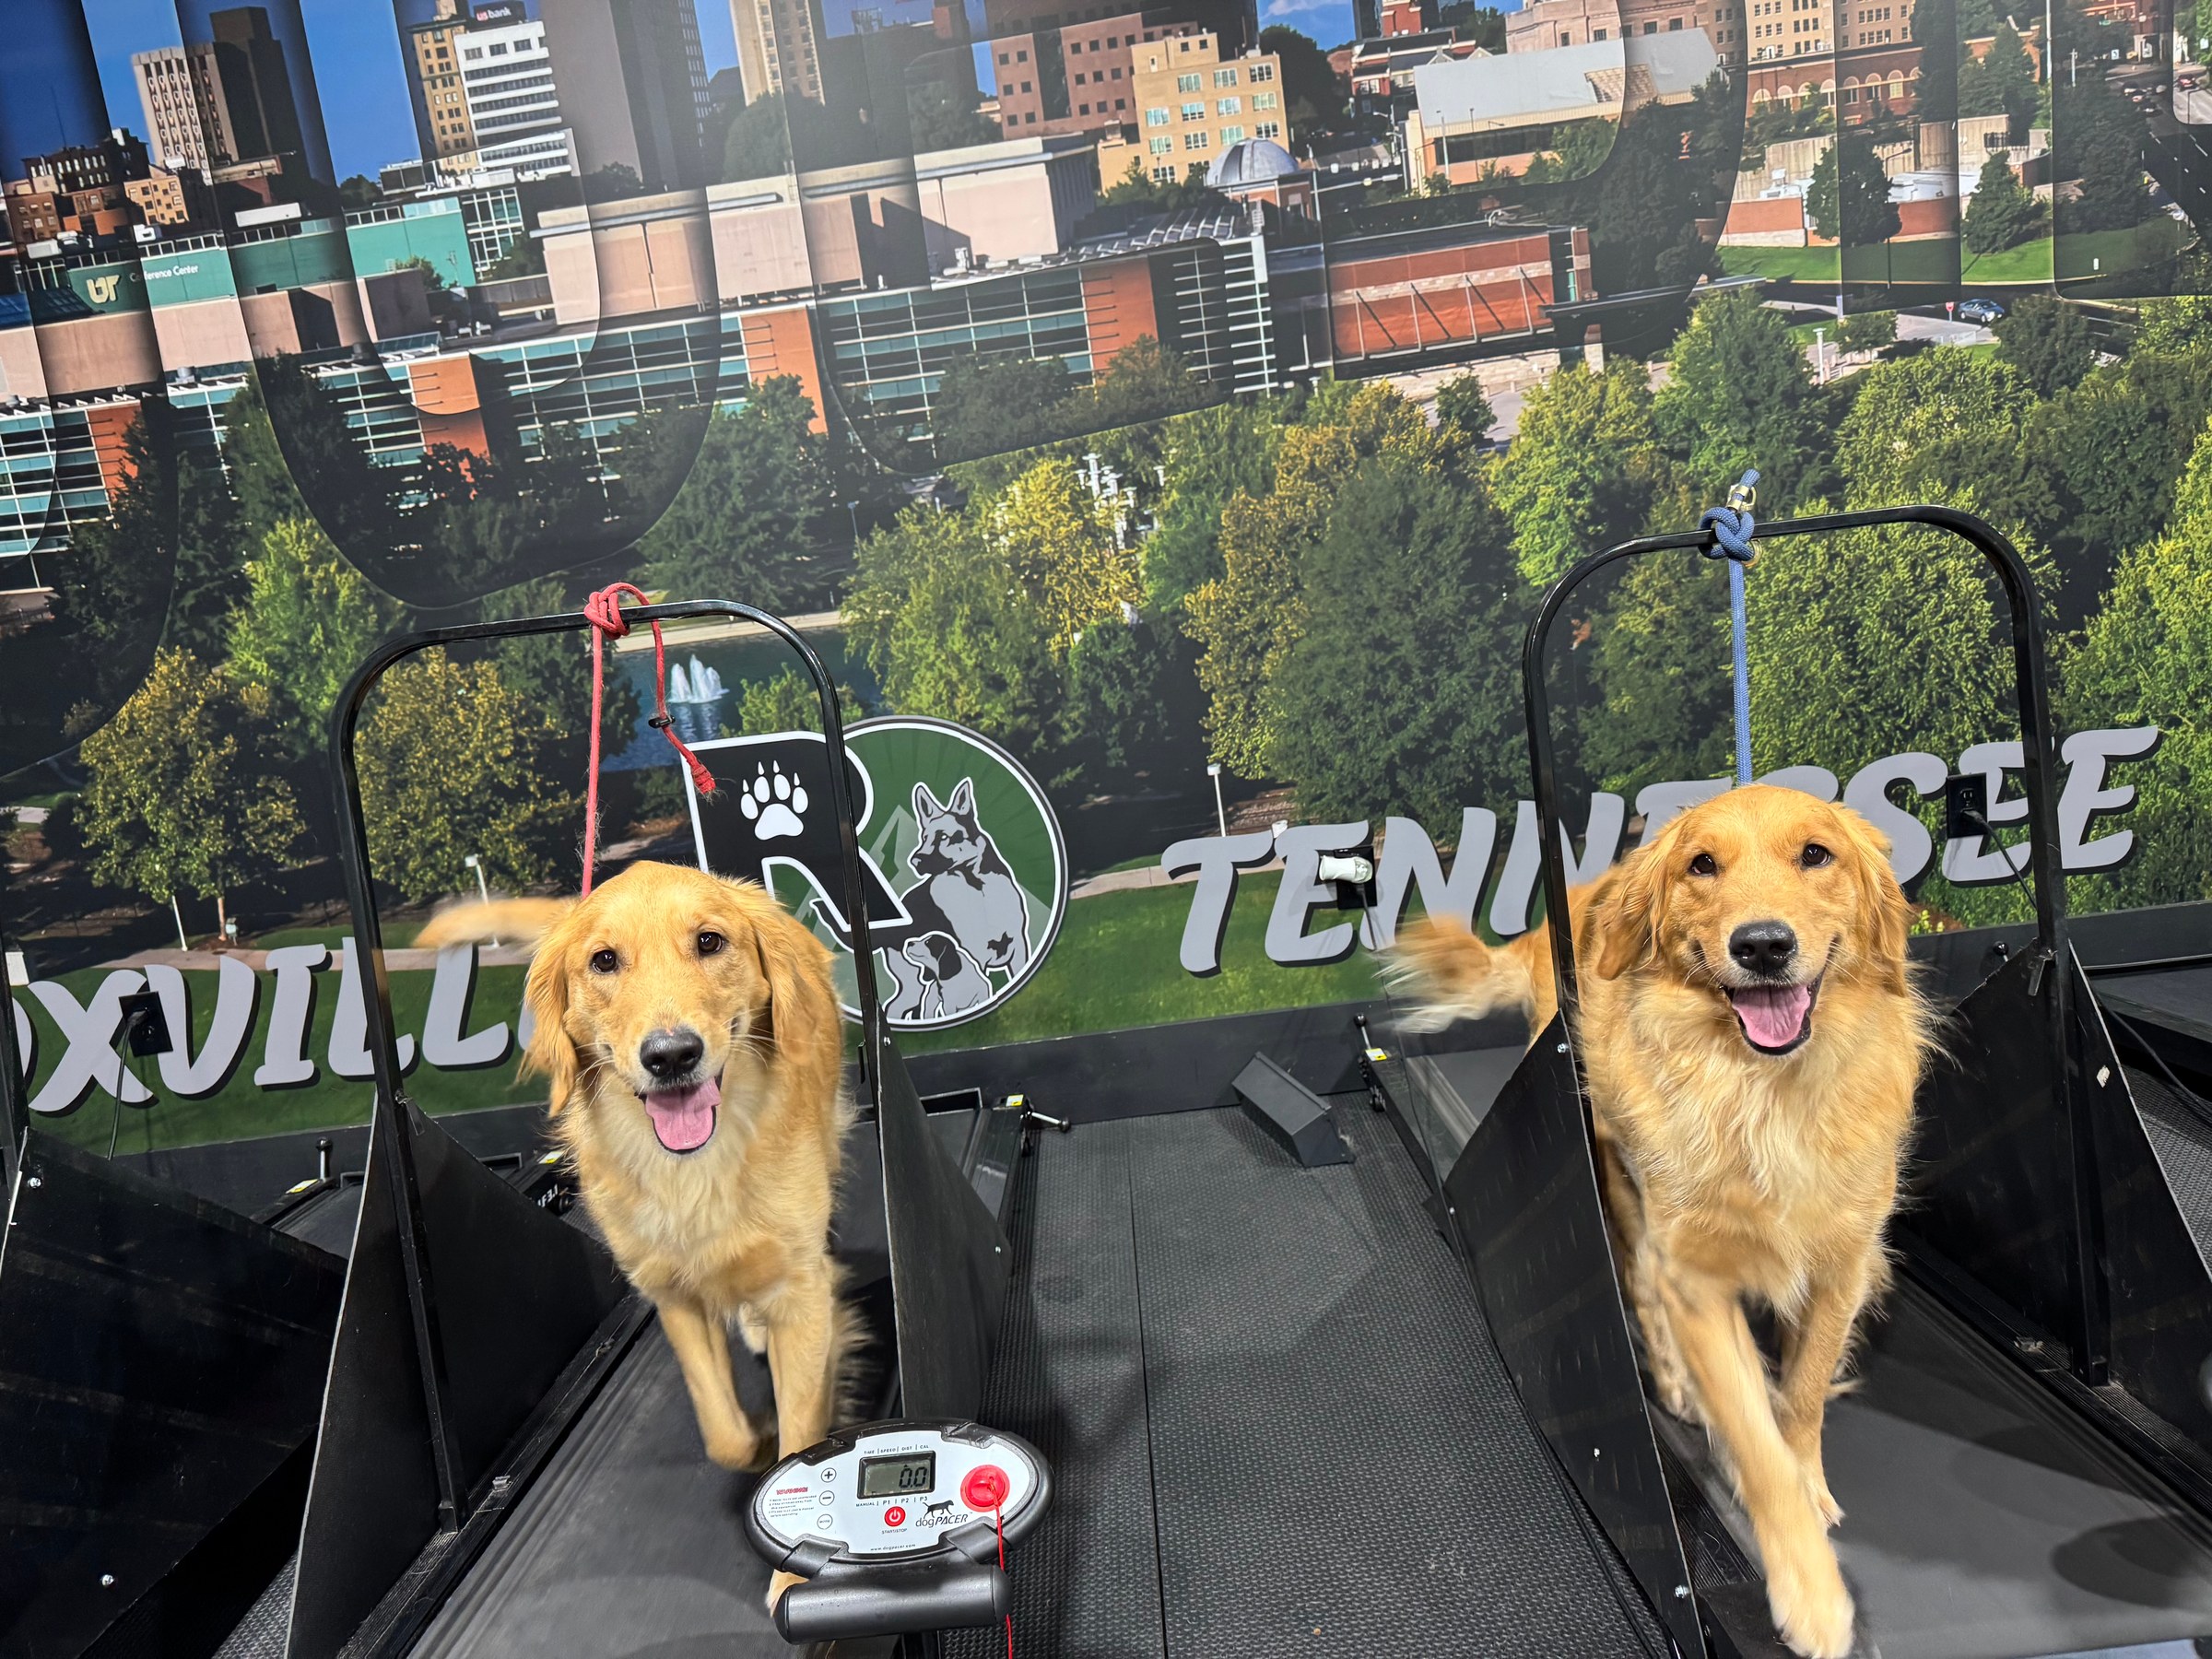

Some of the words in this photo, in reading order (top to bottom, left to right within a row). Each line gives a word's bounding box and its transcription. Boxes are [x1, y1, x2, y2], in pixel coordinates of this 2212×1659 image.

[172, 265, 199, 276] Center
[86, 275, 120, 304] UT
[1162, 724, 2159, 975] TENNSEE
[12, 935, 539, 1112] XVILL
[899, 1466, 927, 1488] 0.0
